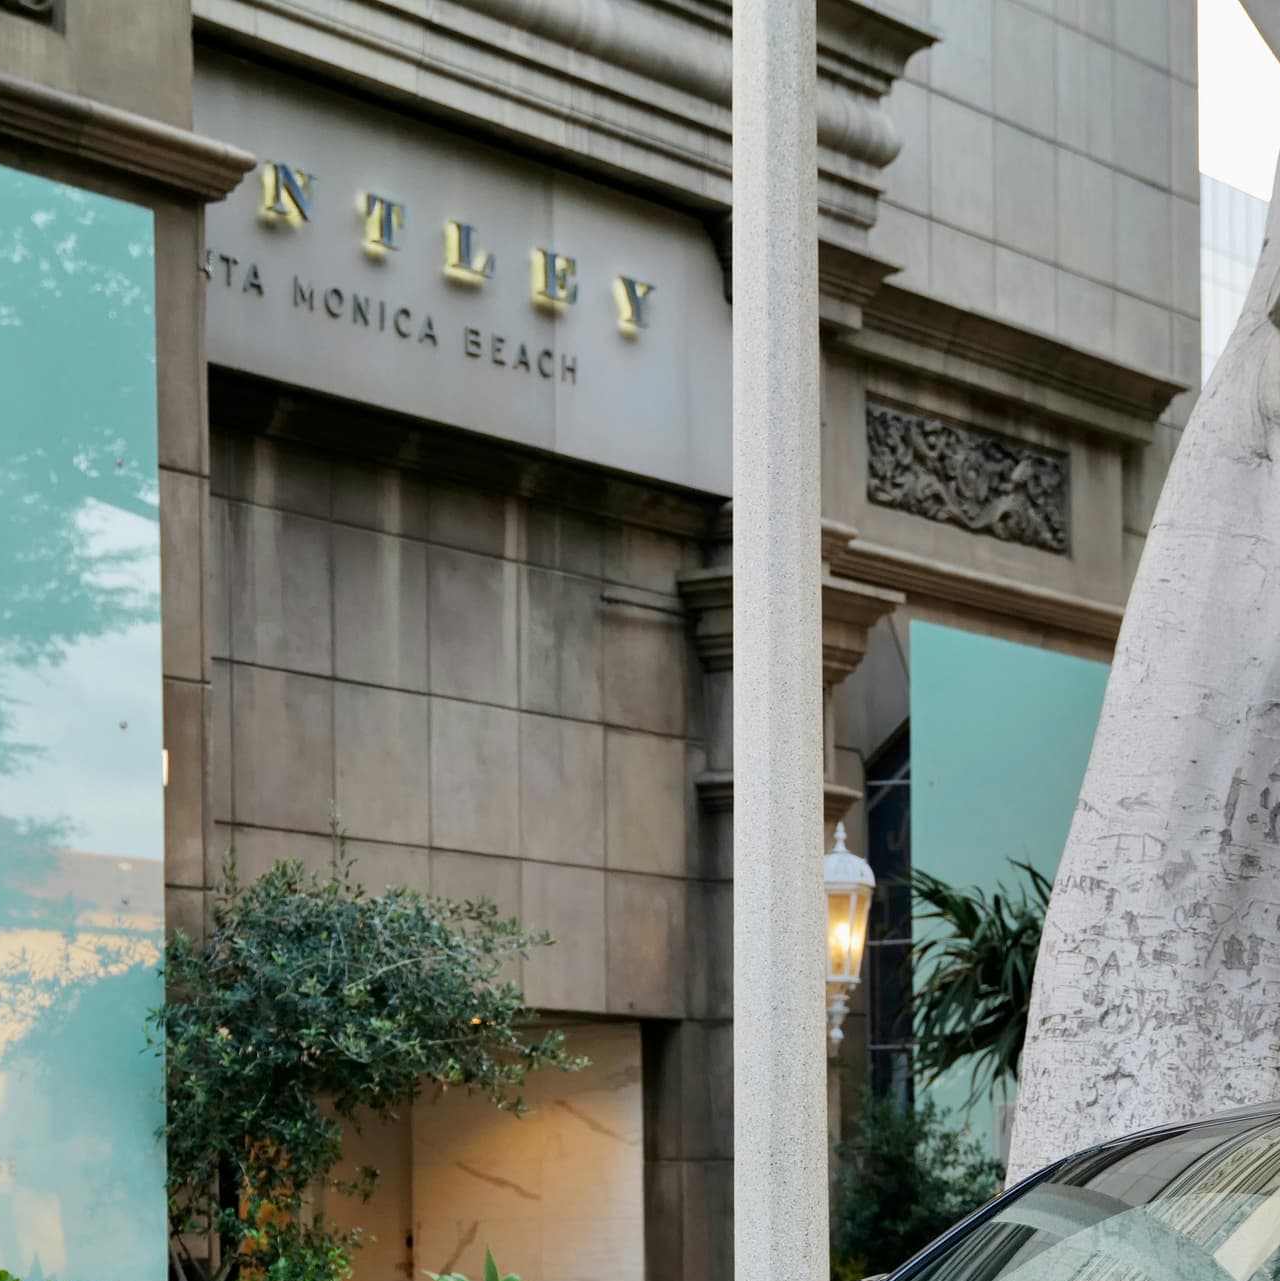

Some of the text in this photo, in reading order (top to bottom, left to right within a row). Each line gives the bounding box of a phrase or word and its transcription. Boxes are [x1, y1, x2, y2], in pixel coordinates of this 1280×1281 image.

[261, 160, 657, 333] NTLEY
[293, 274, 437, 347] MONICA
[464, 325, 577, 385] BEACH
